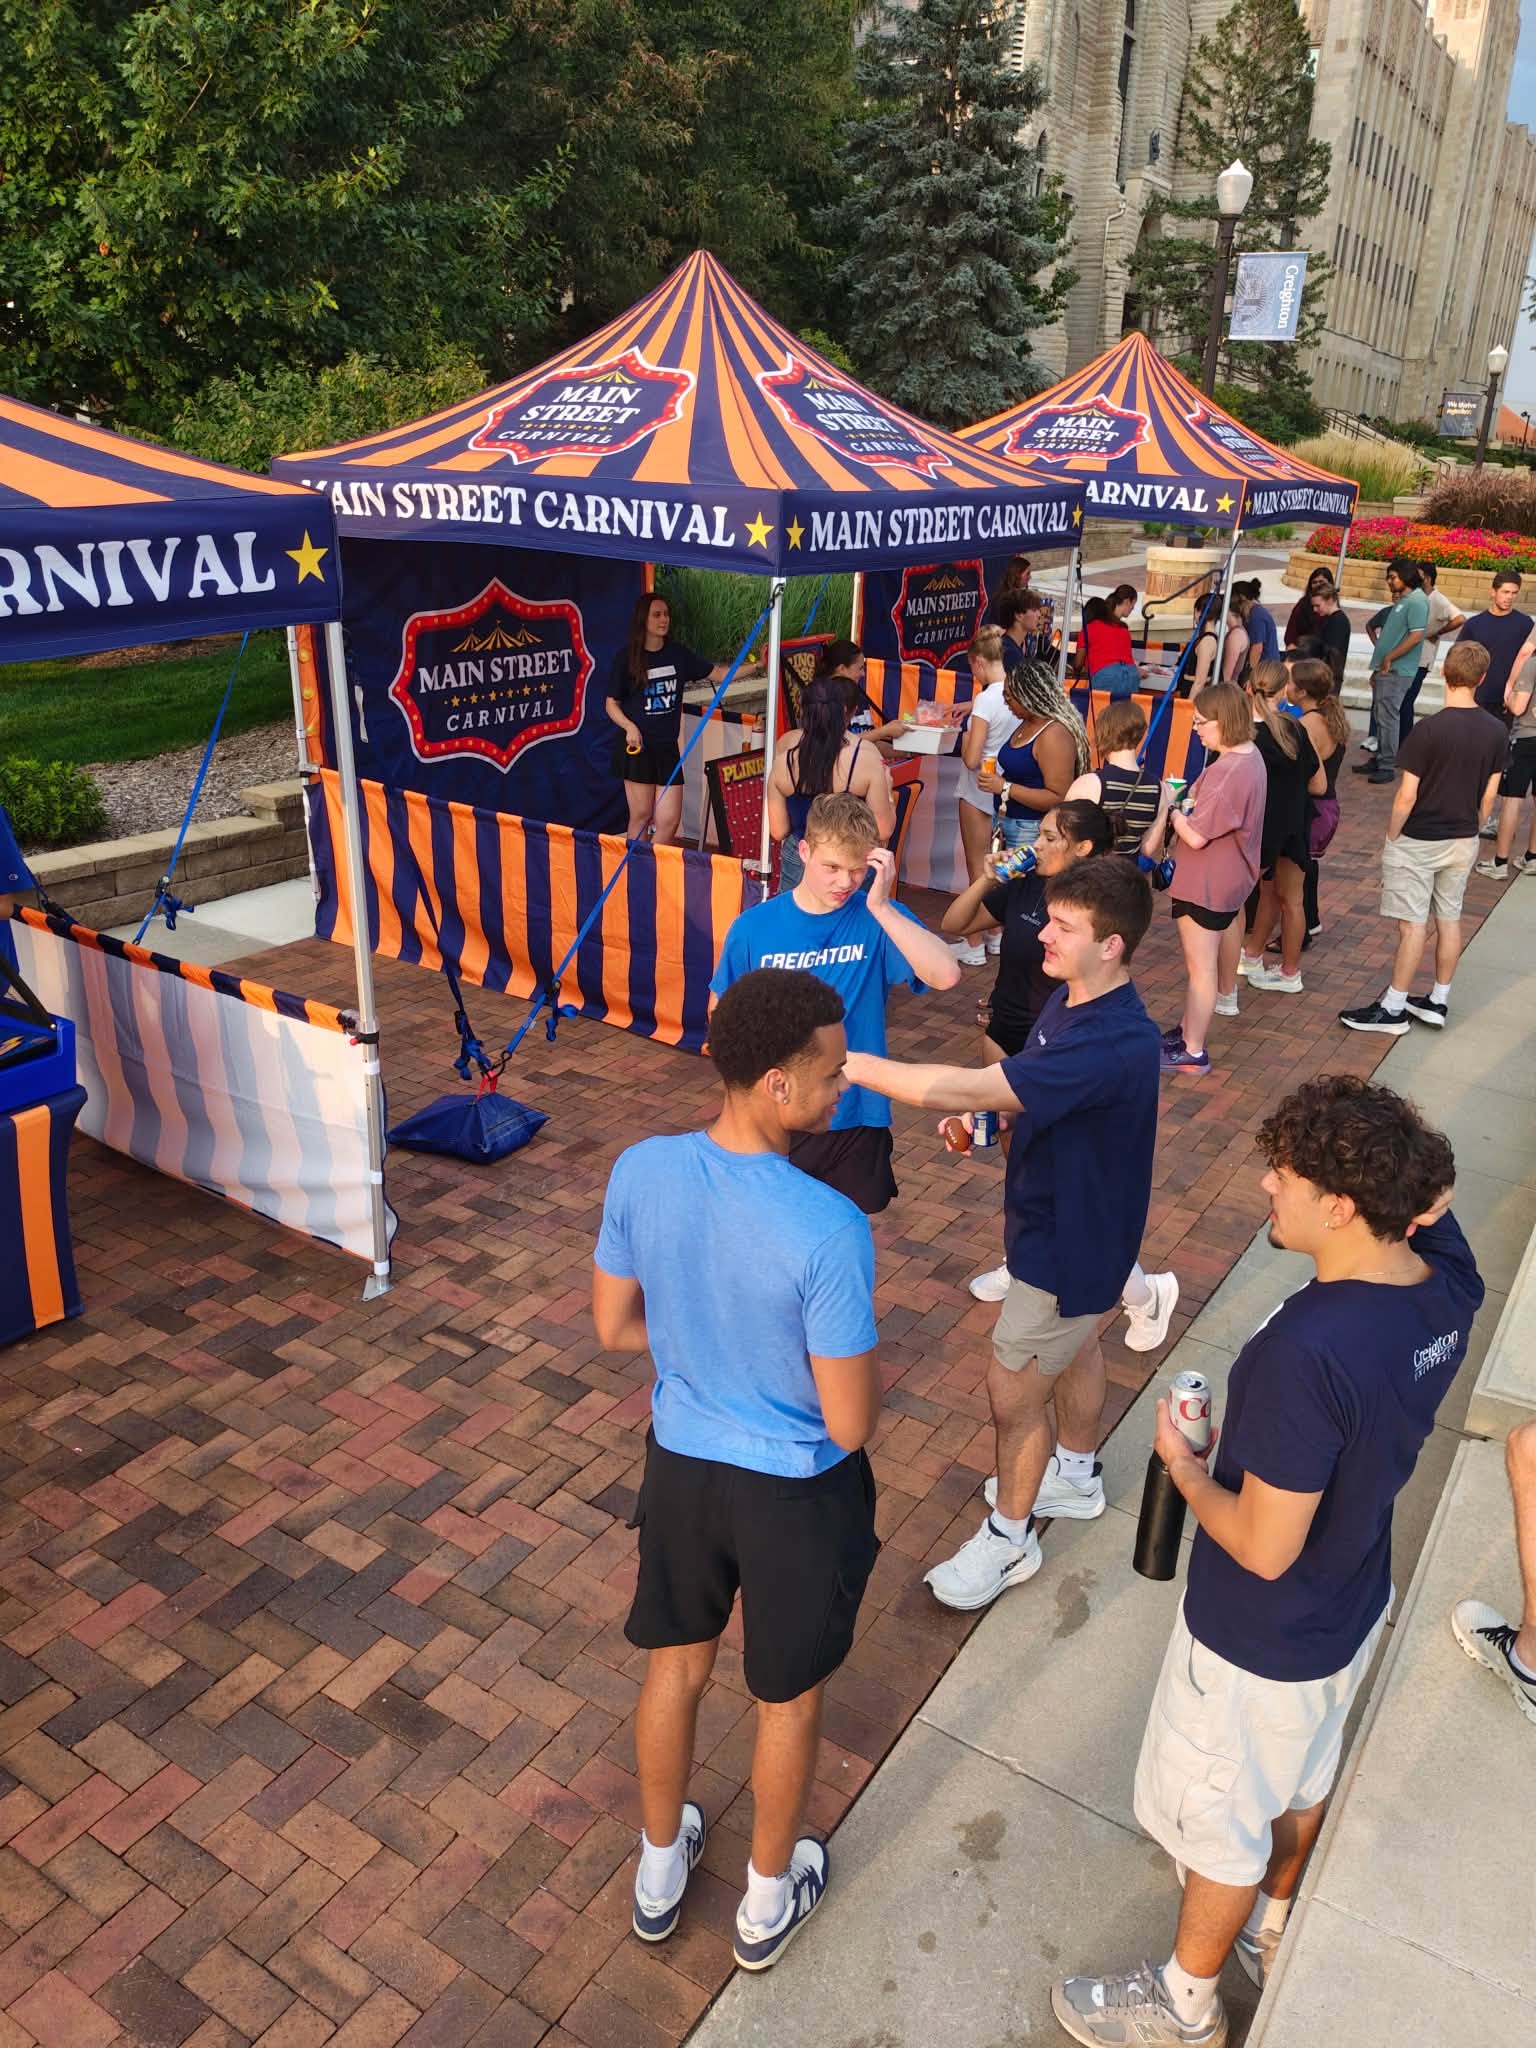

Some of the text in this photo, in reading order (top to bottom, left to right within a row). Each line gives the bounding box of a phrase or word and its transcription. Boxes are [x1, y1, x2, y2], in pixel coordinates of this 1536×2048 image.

[1277, 264, 1299, 329] Creighton
[552, 386, 642, 404] MAIN
[803, 392, 871, 414] MAIN
[519, 405, 640, 424] STREET
[816, 412, 900, 434] STREET
[1052, 416, 1116, 430] MAIN
[498, 430, 613, 444] CARNIVAL
[1033, 428, 1119, 441] STREET
[850, 442, 928, 454] CARNIVAL
[1023, 443, 1109, 453] CARNIVAL
[302, 479, 736, 547] AIN STREET CARNIVAL
[1252, 488, 1349, 516] MAIN STREET CARNIVAL
[810, 501, 1069, 552] MAIN STREET CARNIVAL
[906, 590, 978, 617] MAIN STREET
[914, 625, 966, 645] CARNIVAL
[418, 649, 573, 694] MAIN STREET
[447, 700, 555, 732] CARNIVAL
